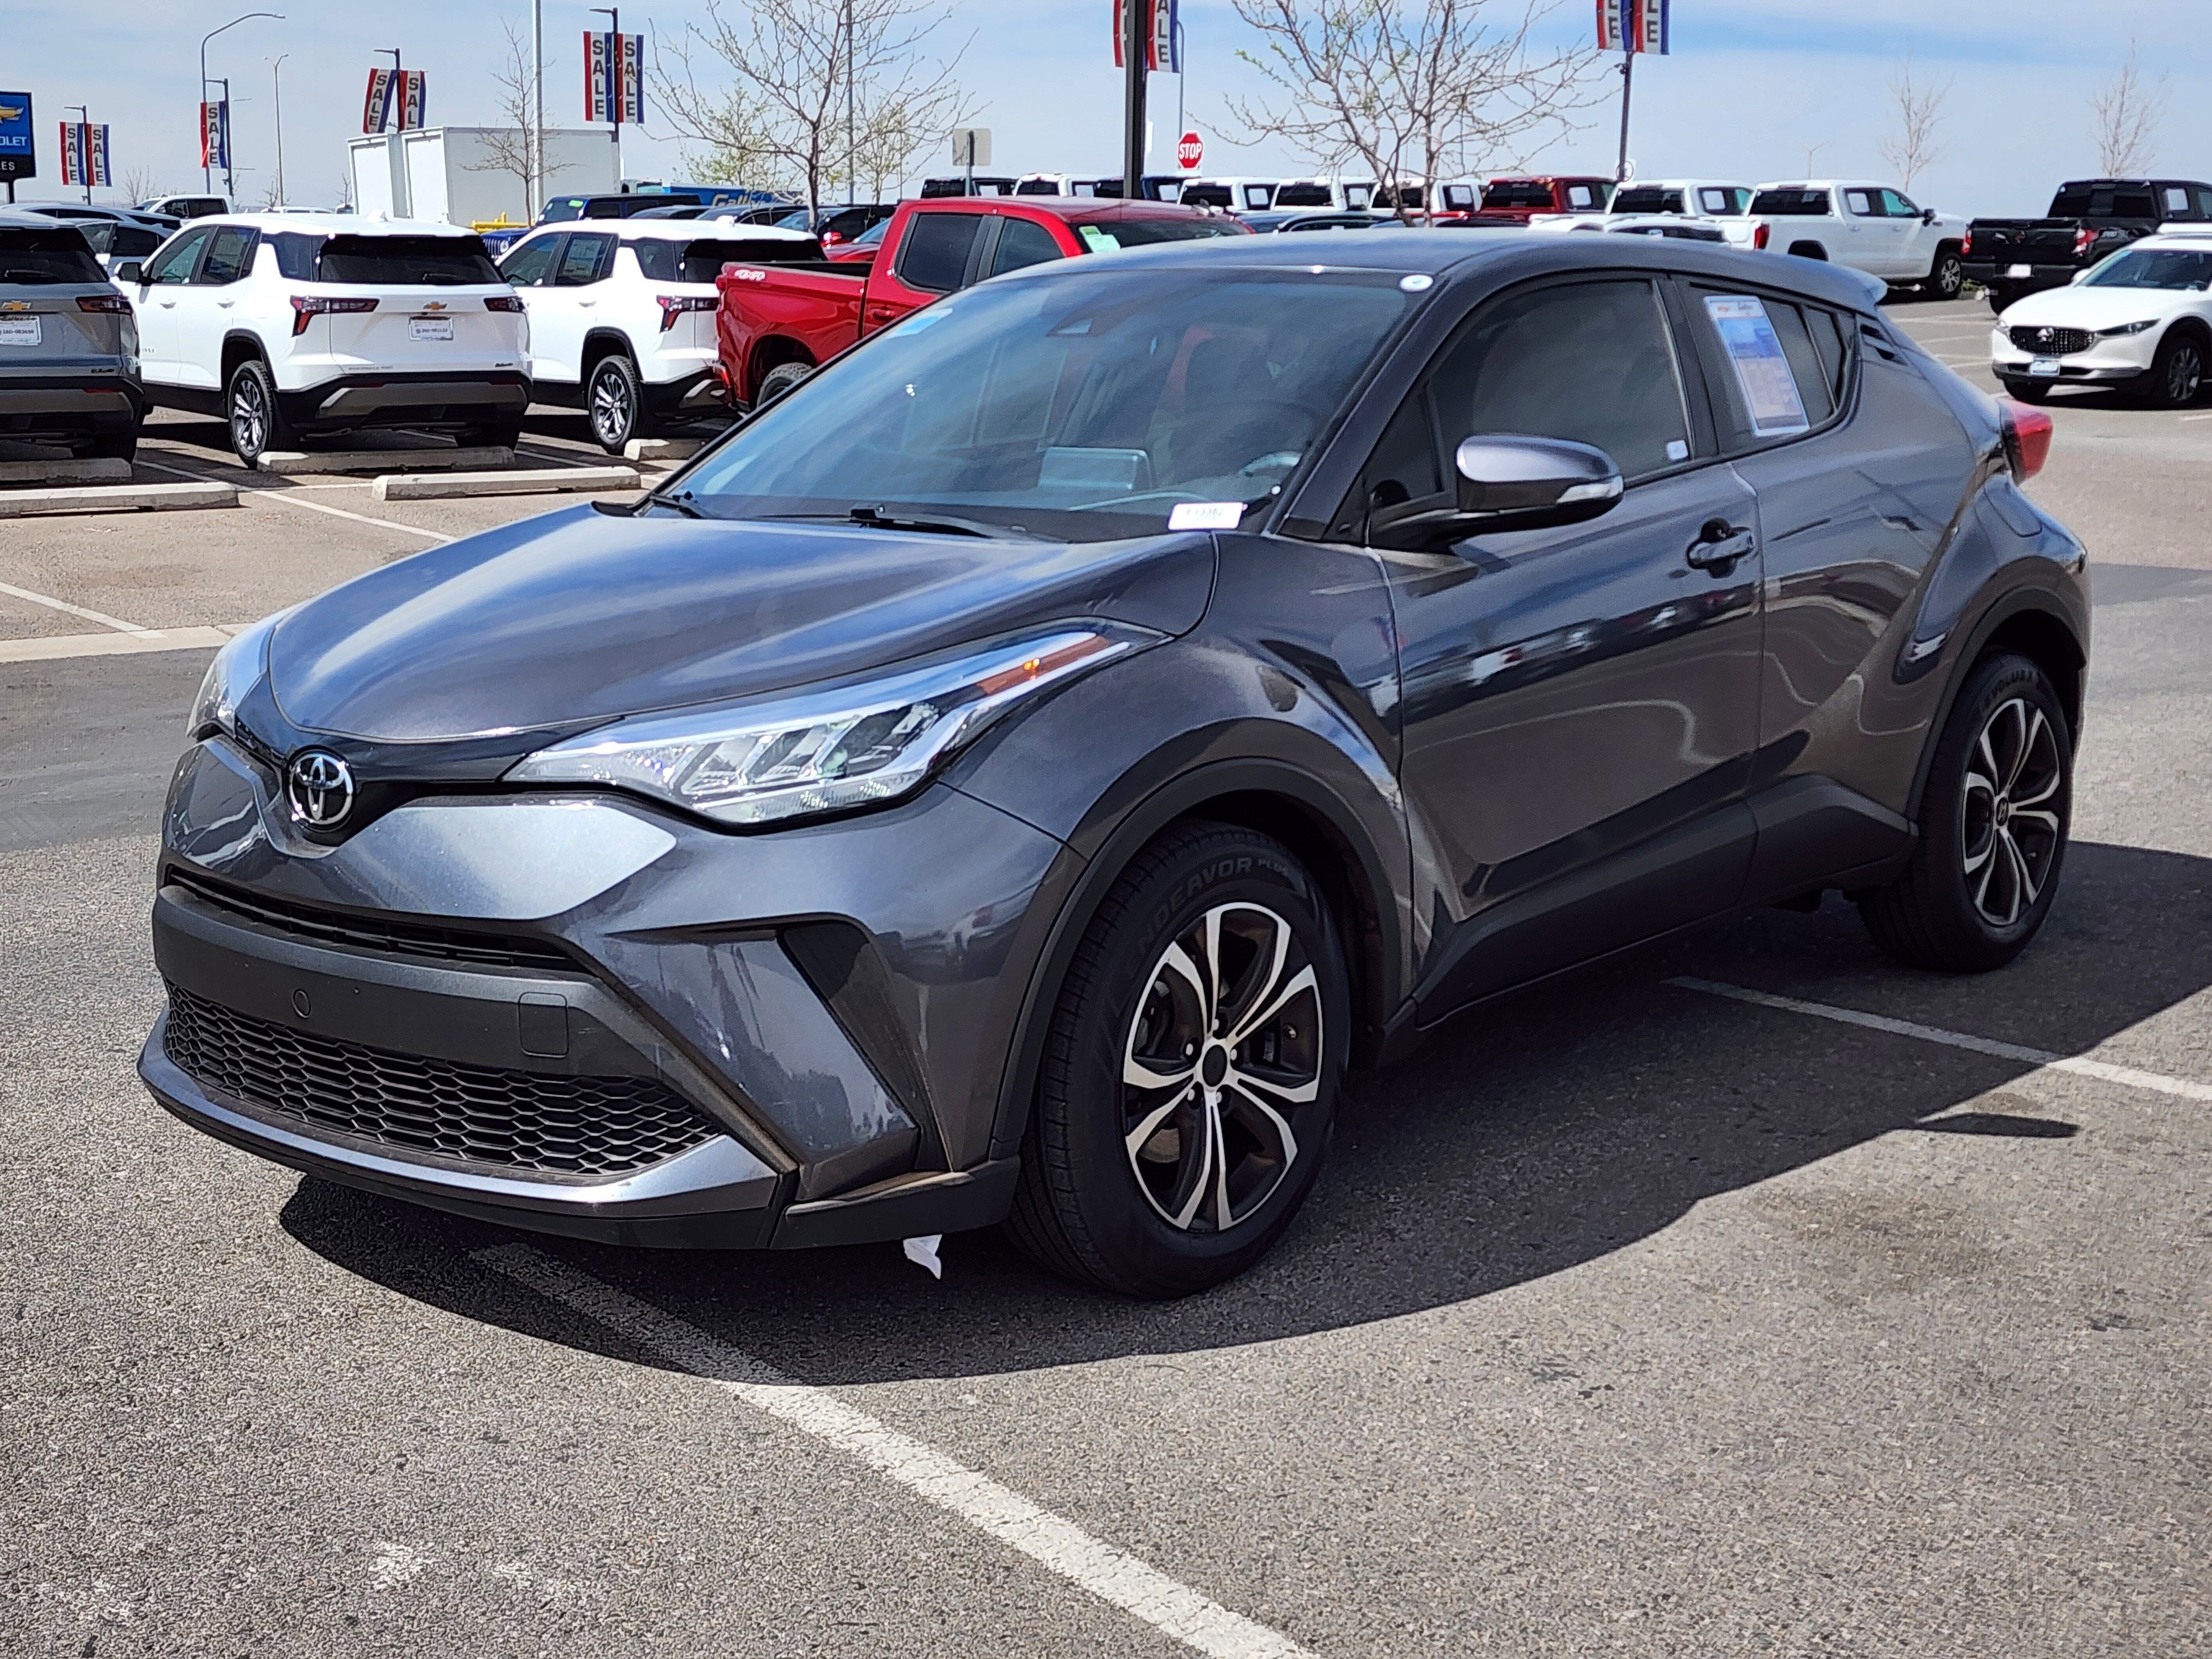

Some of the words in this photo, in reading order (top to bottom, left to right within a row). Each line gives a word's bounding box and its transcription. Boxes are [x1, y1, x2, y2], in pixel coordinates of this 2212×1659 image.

[1157, 0, 1169, 62] ALE
[369, 75, 387, 126] SALE
[406, 77, 419, 130] SAL
[592, 40, 604, 114] SALE
[624, 41, 636, 116] SALE
[67, 128, 77, 181] SALE
[93, 129, 104, 181] SALE
[208, 107, 218, 164] SALE
[1178, 143, 1202, 159] STOP
[0, 161, 15, 170] ES
